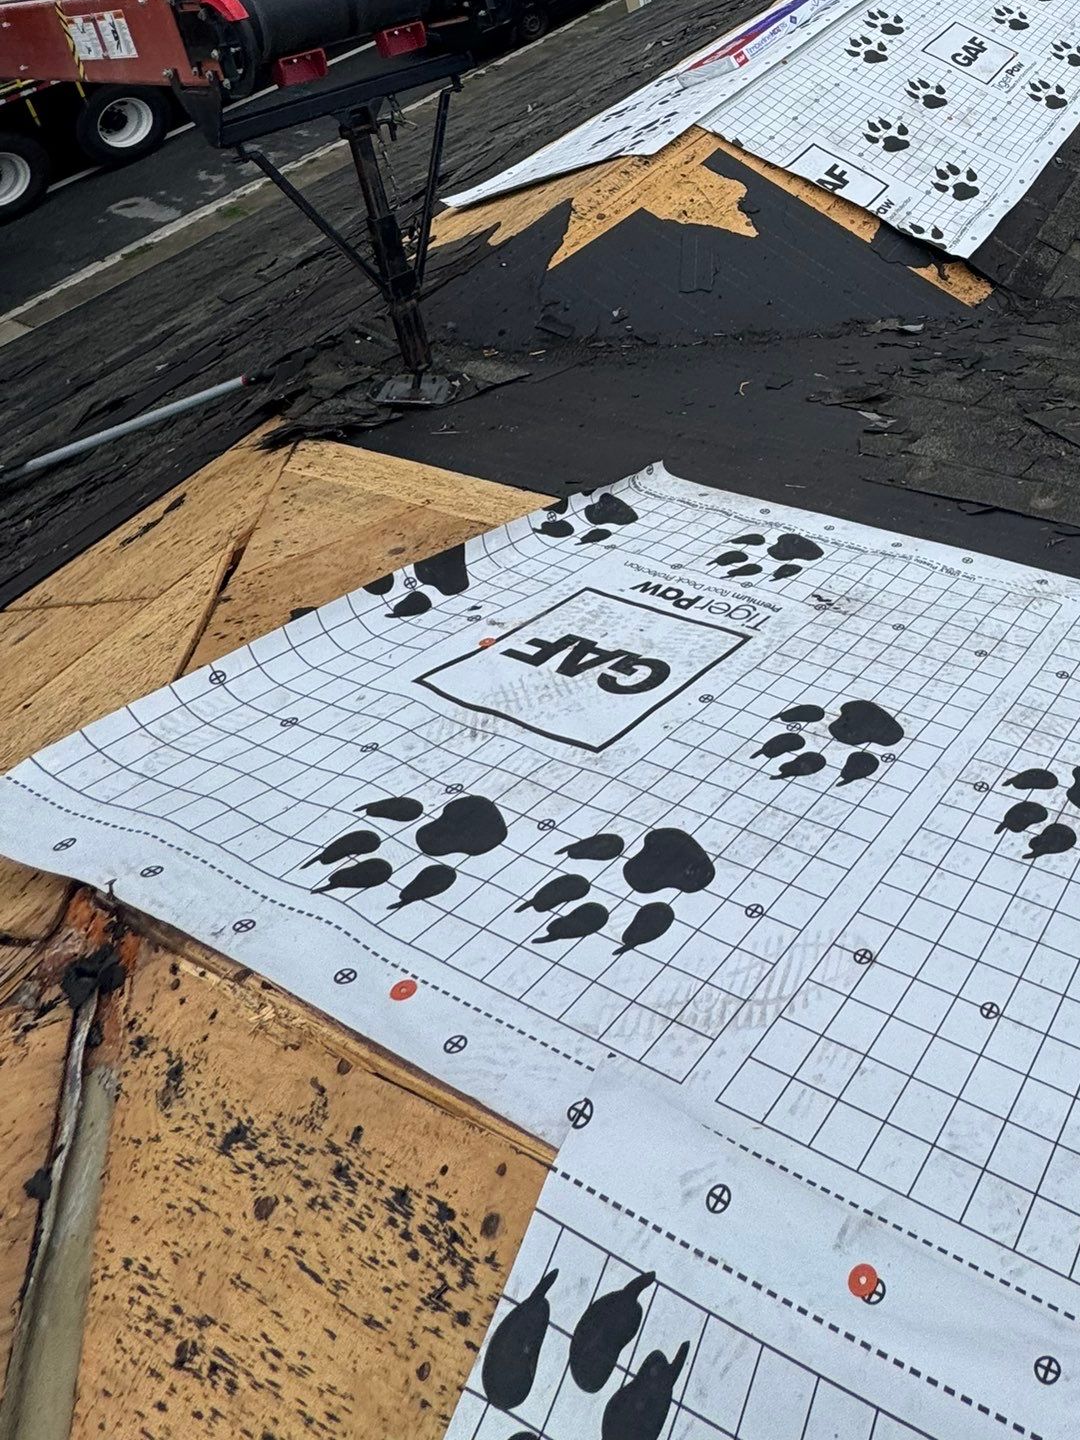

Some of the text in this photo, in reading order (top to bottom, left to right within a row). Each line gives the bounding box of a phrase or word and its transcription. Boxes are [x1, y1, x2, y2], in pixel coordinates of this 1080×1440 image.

[951, 36, 988, 67] GAF
[874, 198, 895, 216] aw
[624, 560, 783, 613] Premium Roof Deck Protection
[500, 634, 670, 694] GAF
